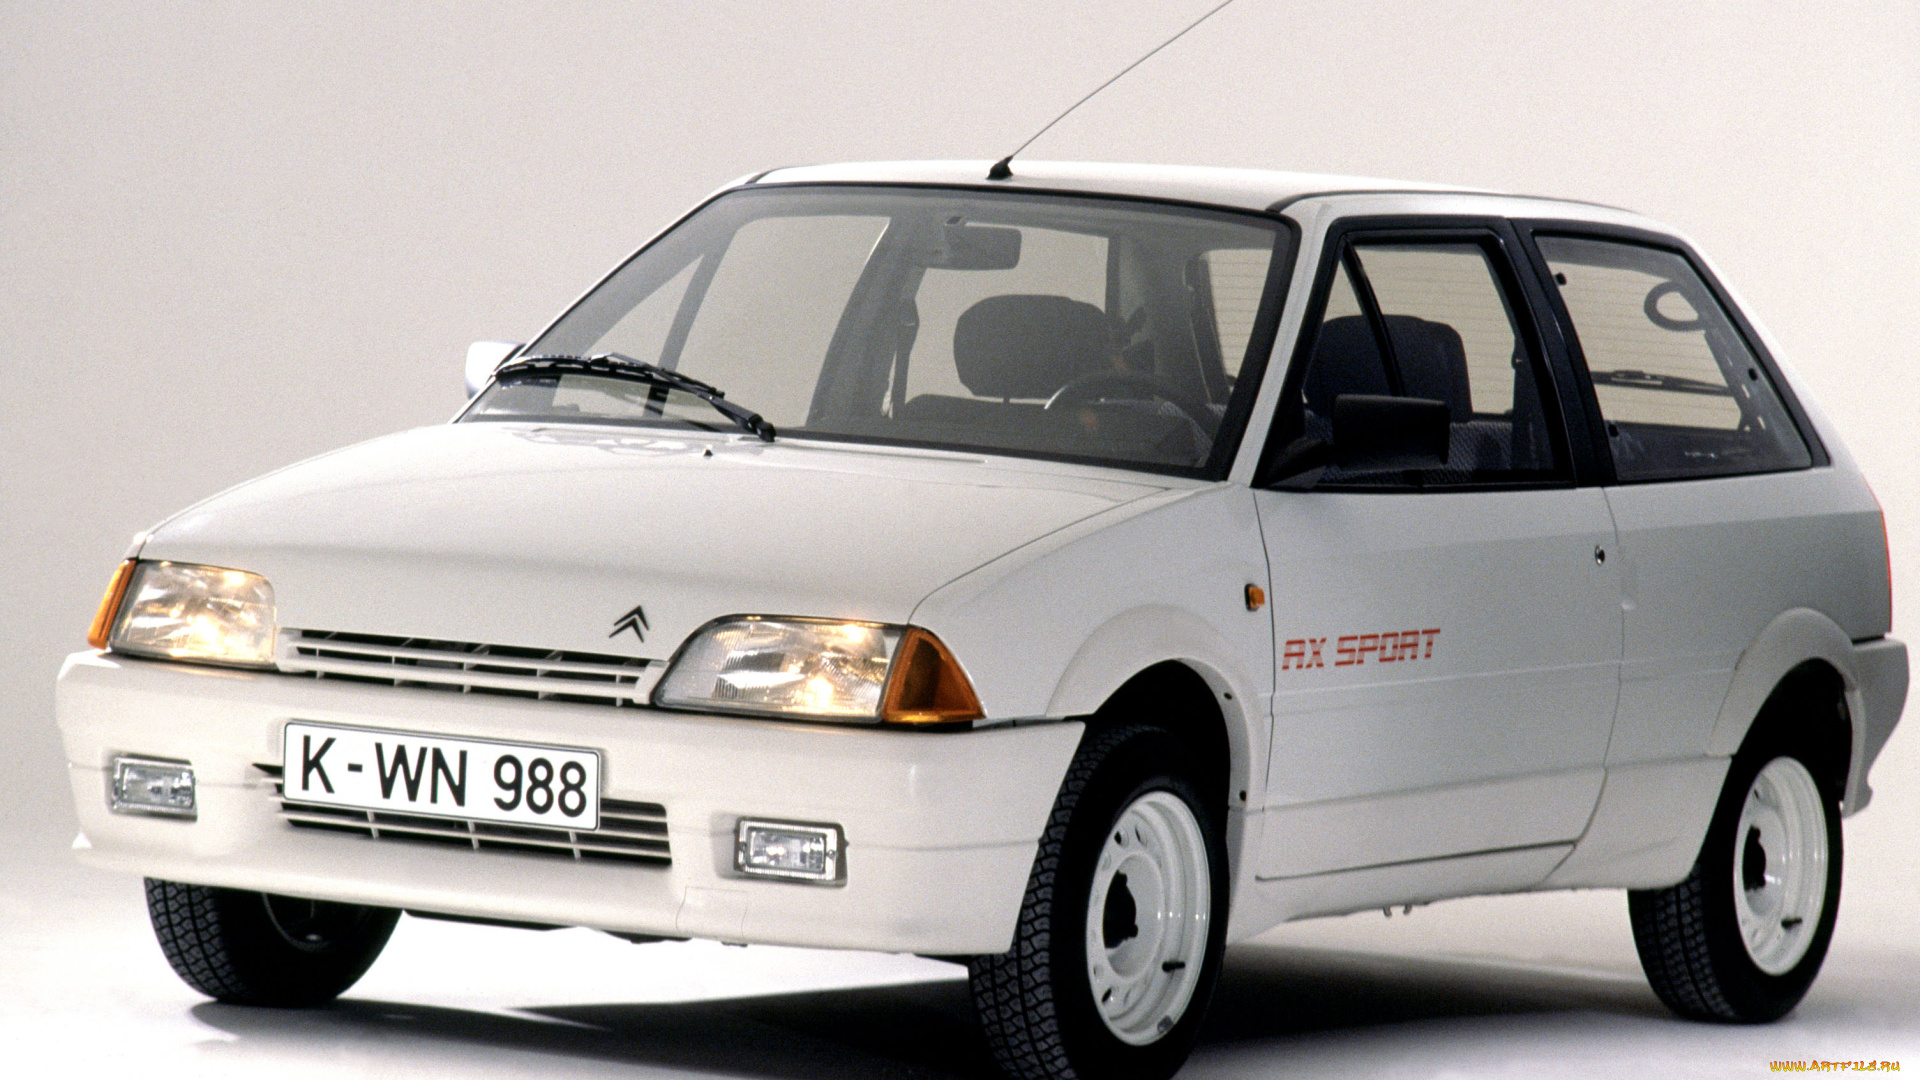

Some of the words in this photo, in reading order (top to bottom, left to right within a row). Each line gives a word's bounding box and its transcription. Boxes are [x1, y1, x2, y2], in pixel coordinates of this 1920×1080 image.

[1282, 638, 1327, 670] AX
[1335, 628, 1441, 666] SPORT
[493, 754, 587, 818] 988
